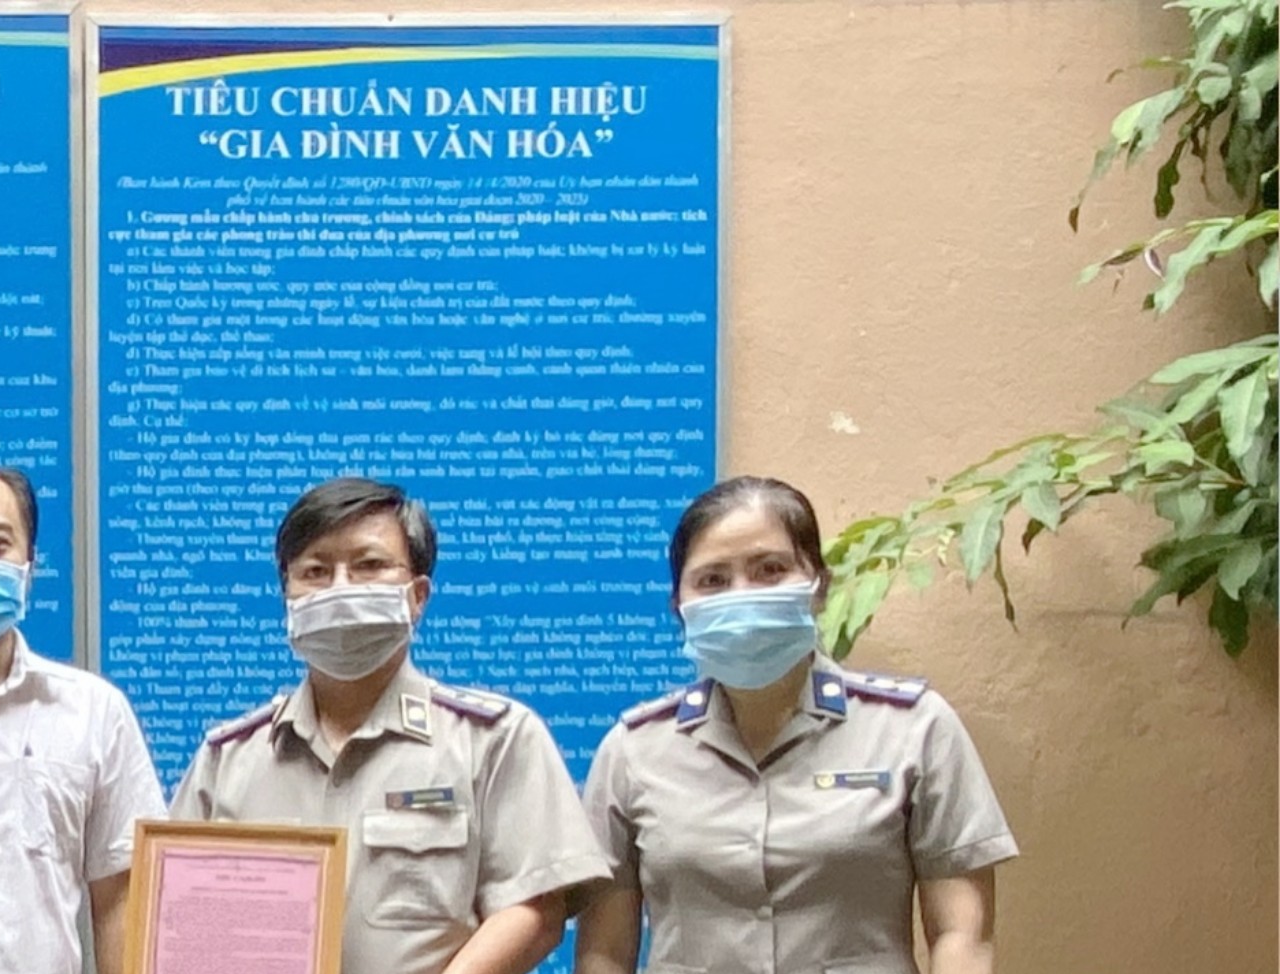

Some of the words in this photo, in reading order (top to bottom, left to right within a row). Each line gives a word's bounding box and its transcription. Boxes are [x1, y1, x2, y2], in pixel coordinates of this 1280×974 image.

[165, 78, 259, 115] TIÊU
[270, 78, 412, 116] CHUẨN
[424, 86, 538, 116] DANH
[548, 82, 647, 122] HIỆU
[198, 128, 291, 159] “GIA
[300, 123, 401, 159] ĐÌNH
[411, 123, 494, 159] VĂN
[506, 121, 614, 158] HÓA”
